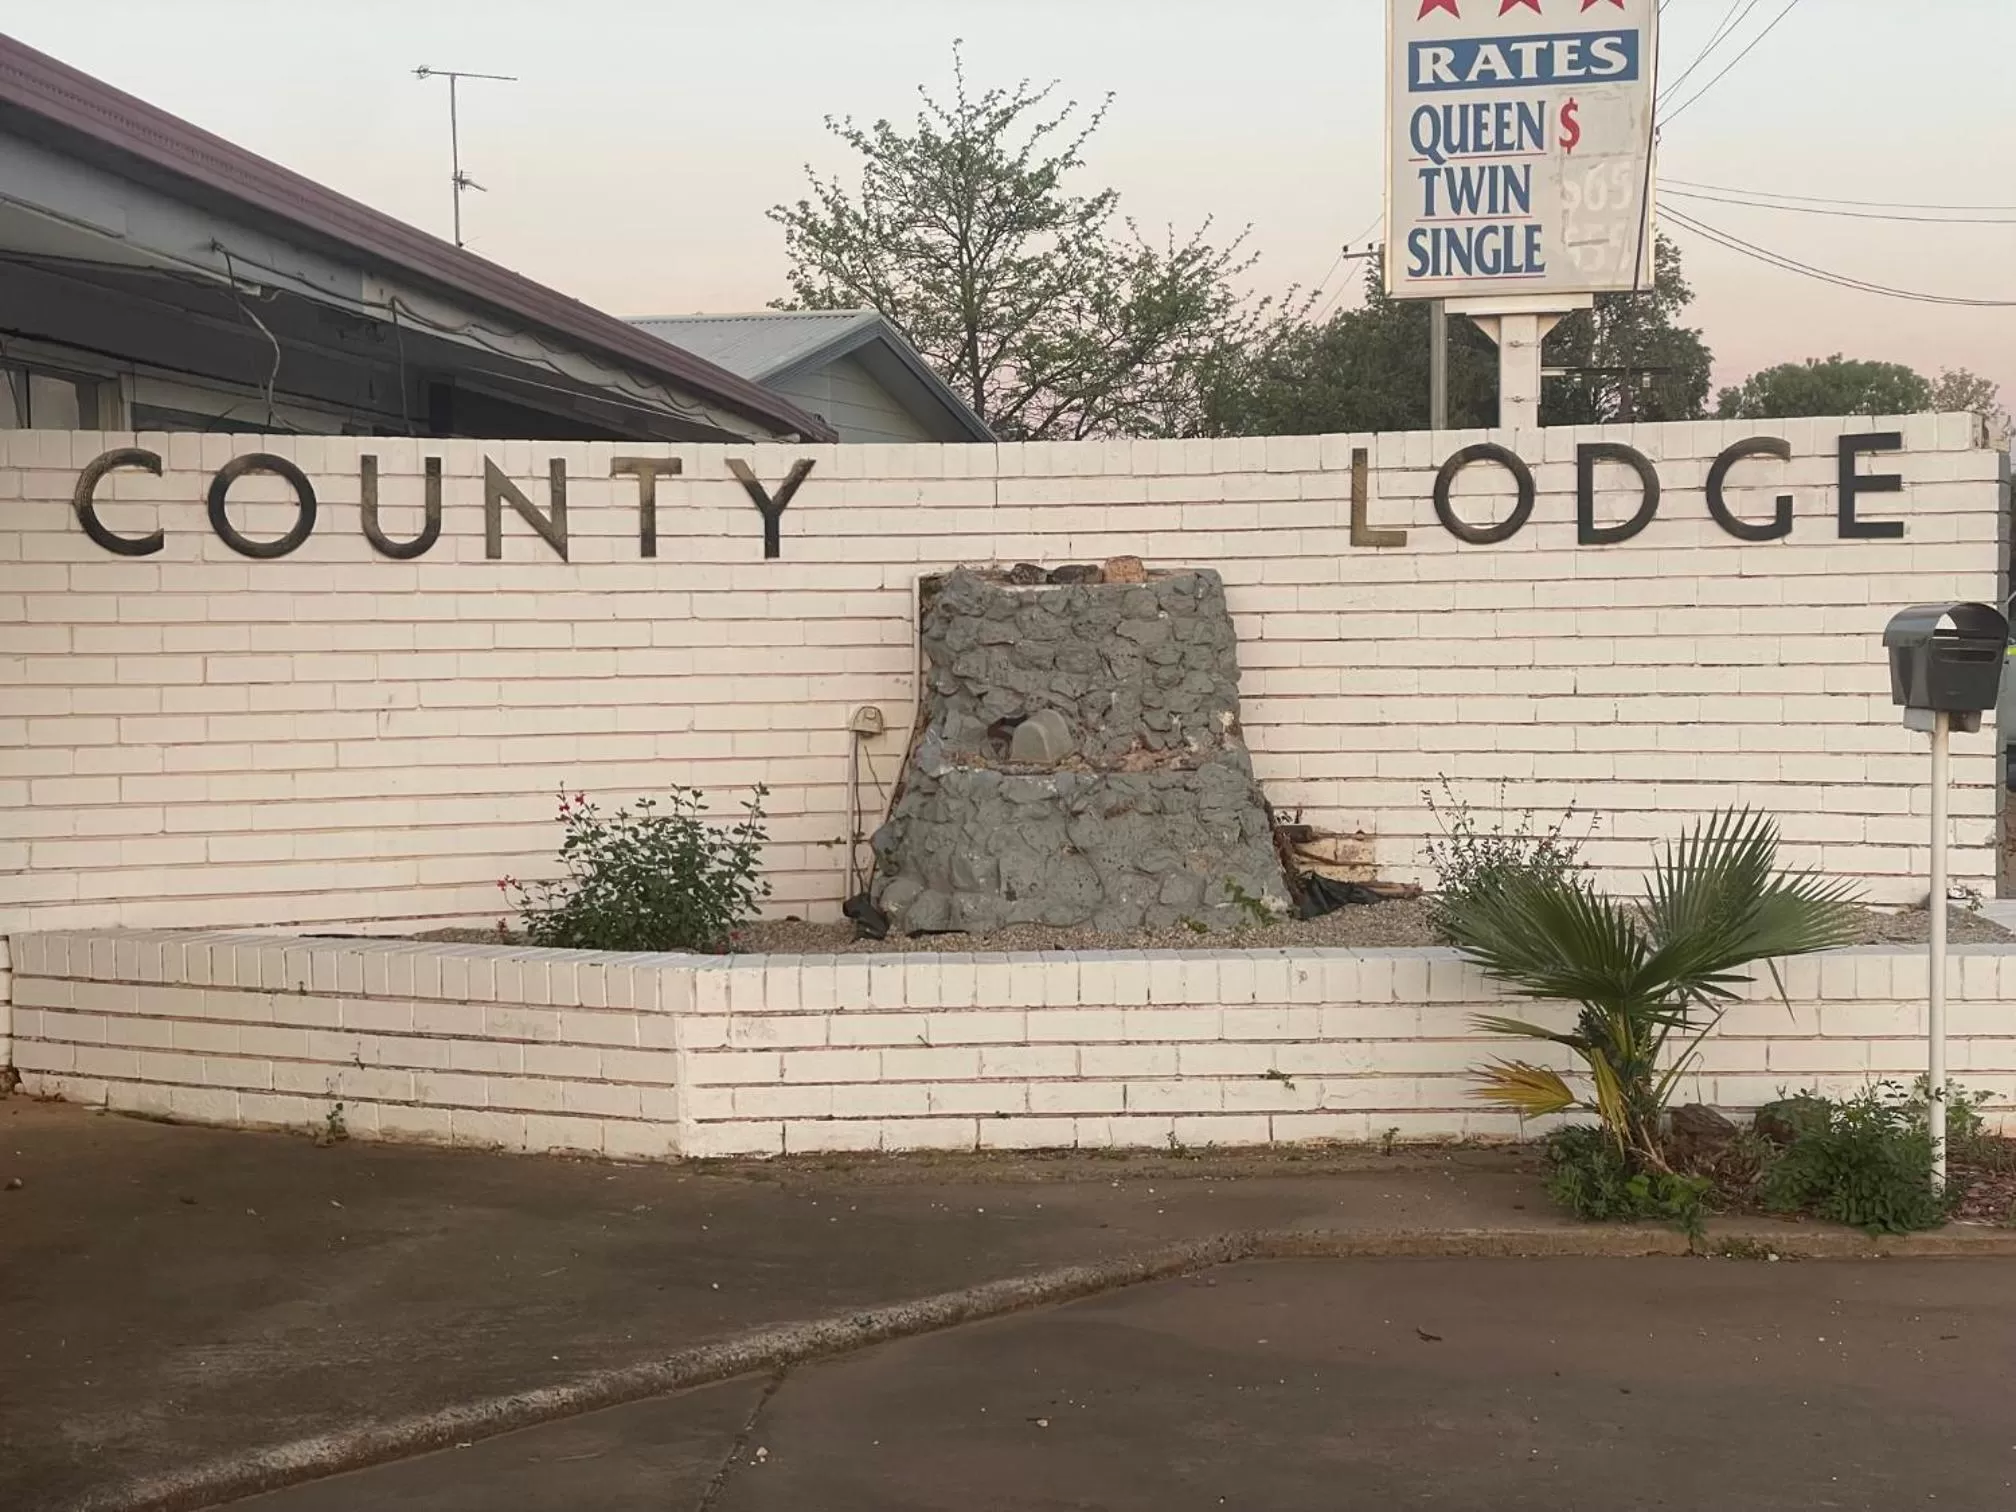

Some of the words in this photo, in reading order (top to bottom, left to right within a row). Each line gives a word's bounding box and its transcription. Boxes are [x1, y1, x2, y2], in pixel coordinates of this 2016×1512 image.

[1416, 36, 1628, 85] RATES
[1409, 100, 1547, 165] QUEEN
[1558, 96, 1581, 154] $
[1418, 163, 1532, 217] TWIN
[1407, 223, 1547, 278] SINGLE
[73, 446, 817, 563] COUNTY
[1350, 430, 1905, 548] LODGE
